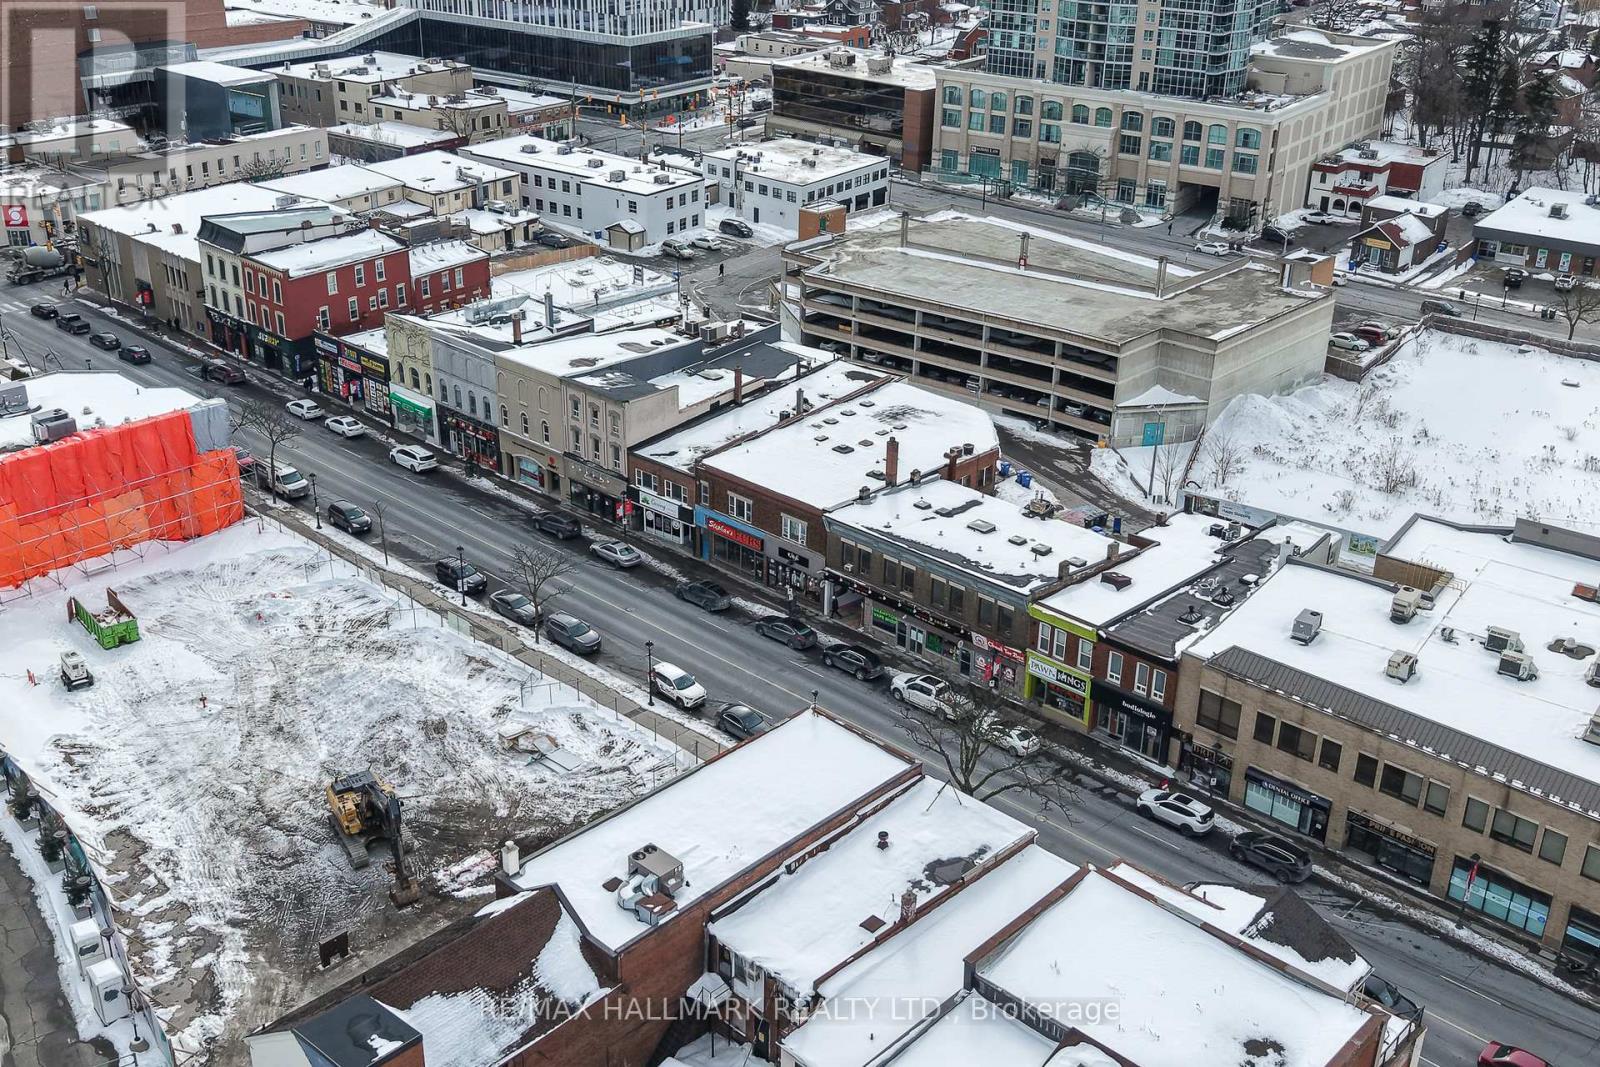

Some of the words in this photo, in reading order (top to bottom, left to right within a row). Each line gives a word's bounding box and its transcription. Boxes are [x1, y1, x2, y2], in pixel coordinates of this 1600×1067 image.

[1031, 660, 1056, 677] PAWN
[1057, 672, 1086, 690] KINGS
[1268, 783, 1289, 797] DENTAL
[1290, 794, 1311, 805] OFFICE
